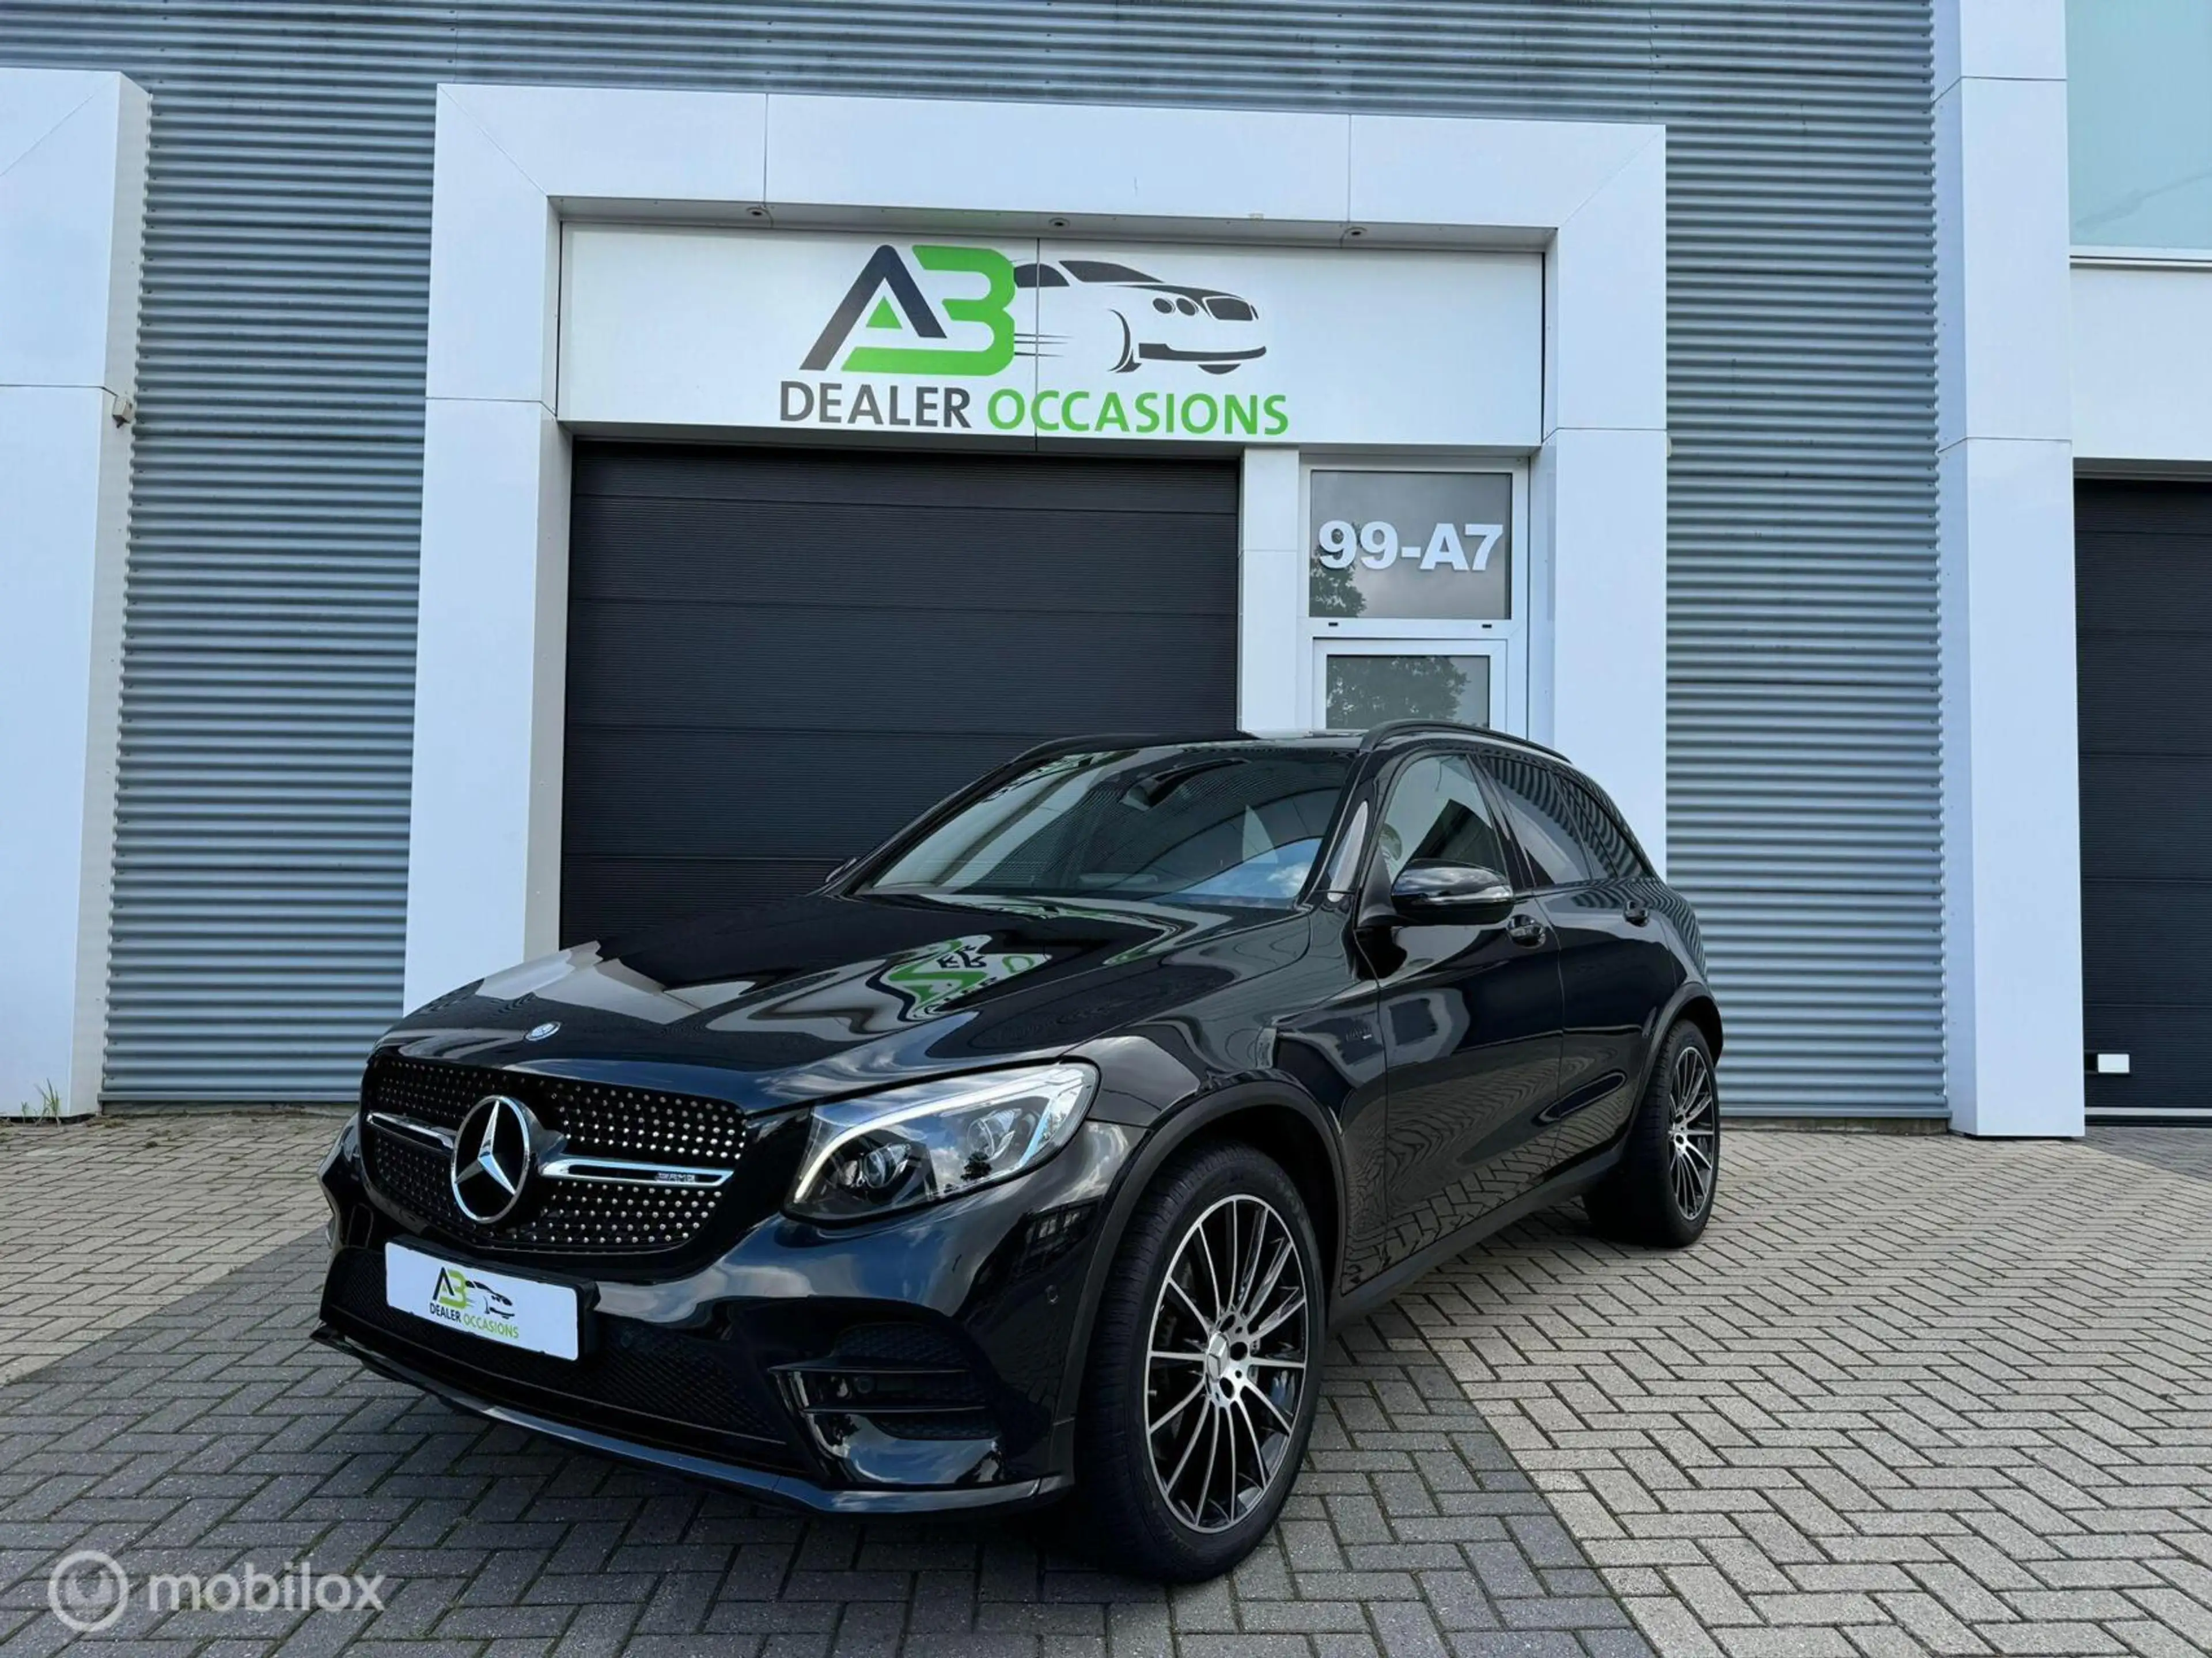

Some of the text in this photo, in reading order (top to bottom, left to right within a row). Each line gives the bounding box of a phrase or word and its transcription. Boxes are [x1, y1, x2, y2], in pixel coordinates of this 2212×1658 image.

[780, 381, 1289, 435] DEALER OCCASIONS
[1319, 521, 1503, 570] 99-A7
[430, 1302, 520, 1339] DEALER OCCASIONS
